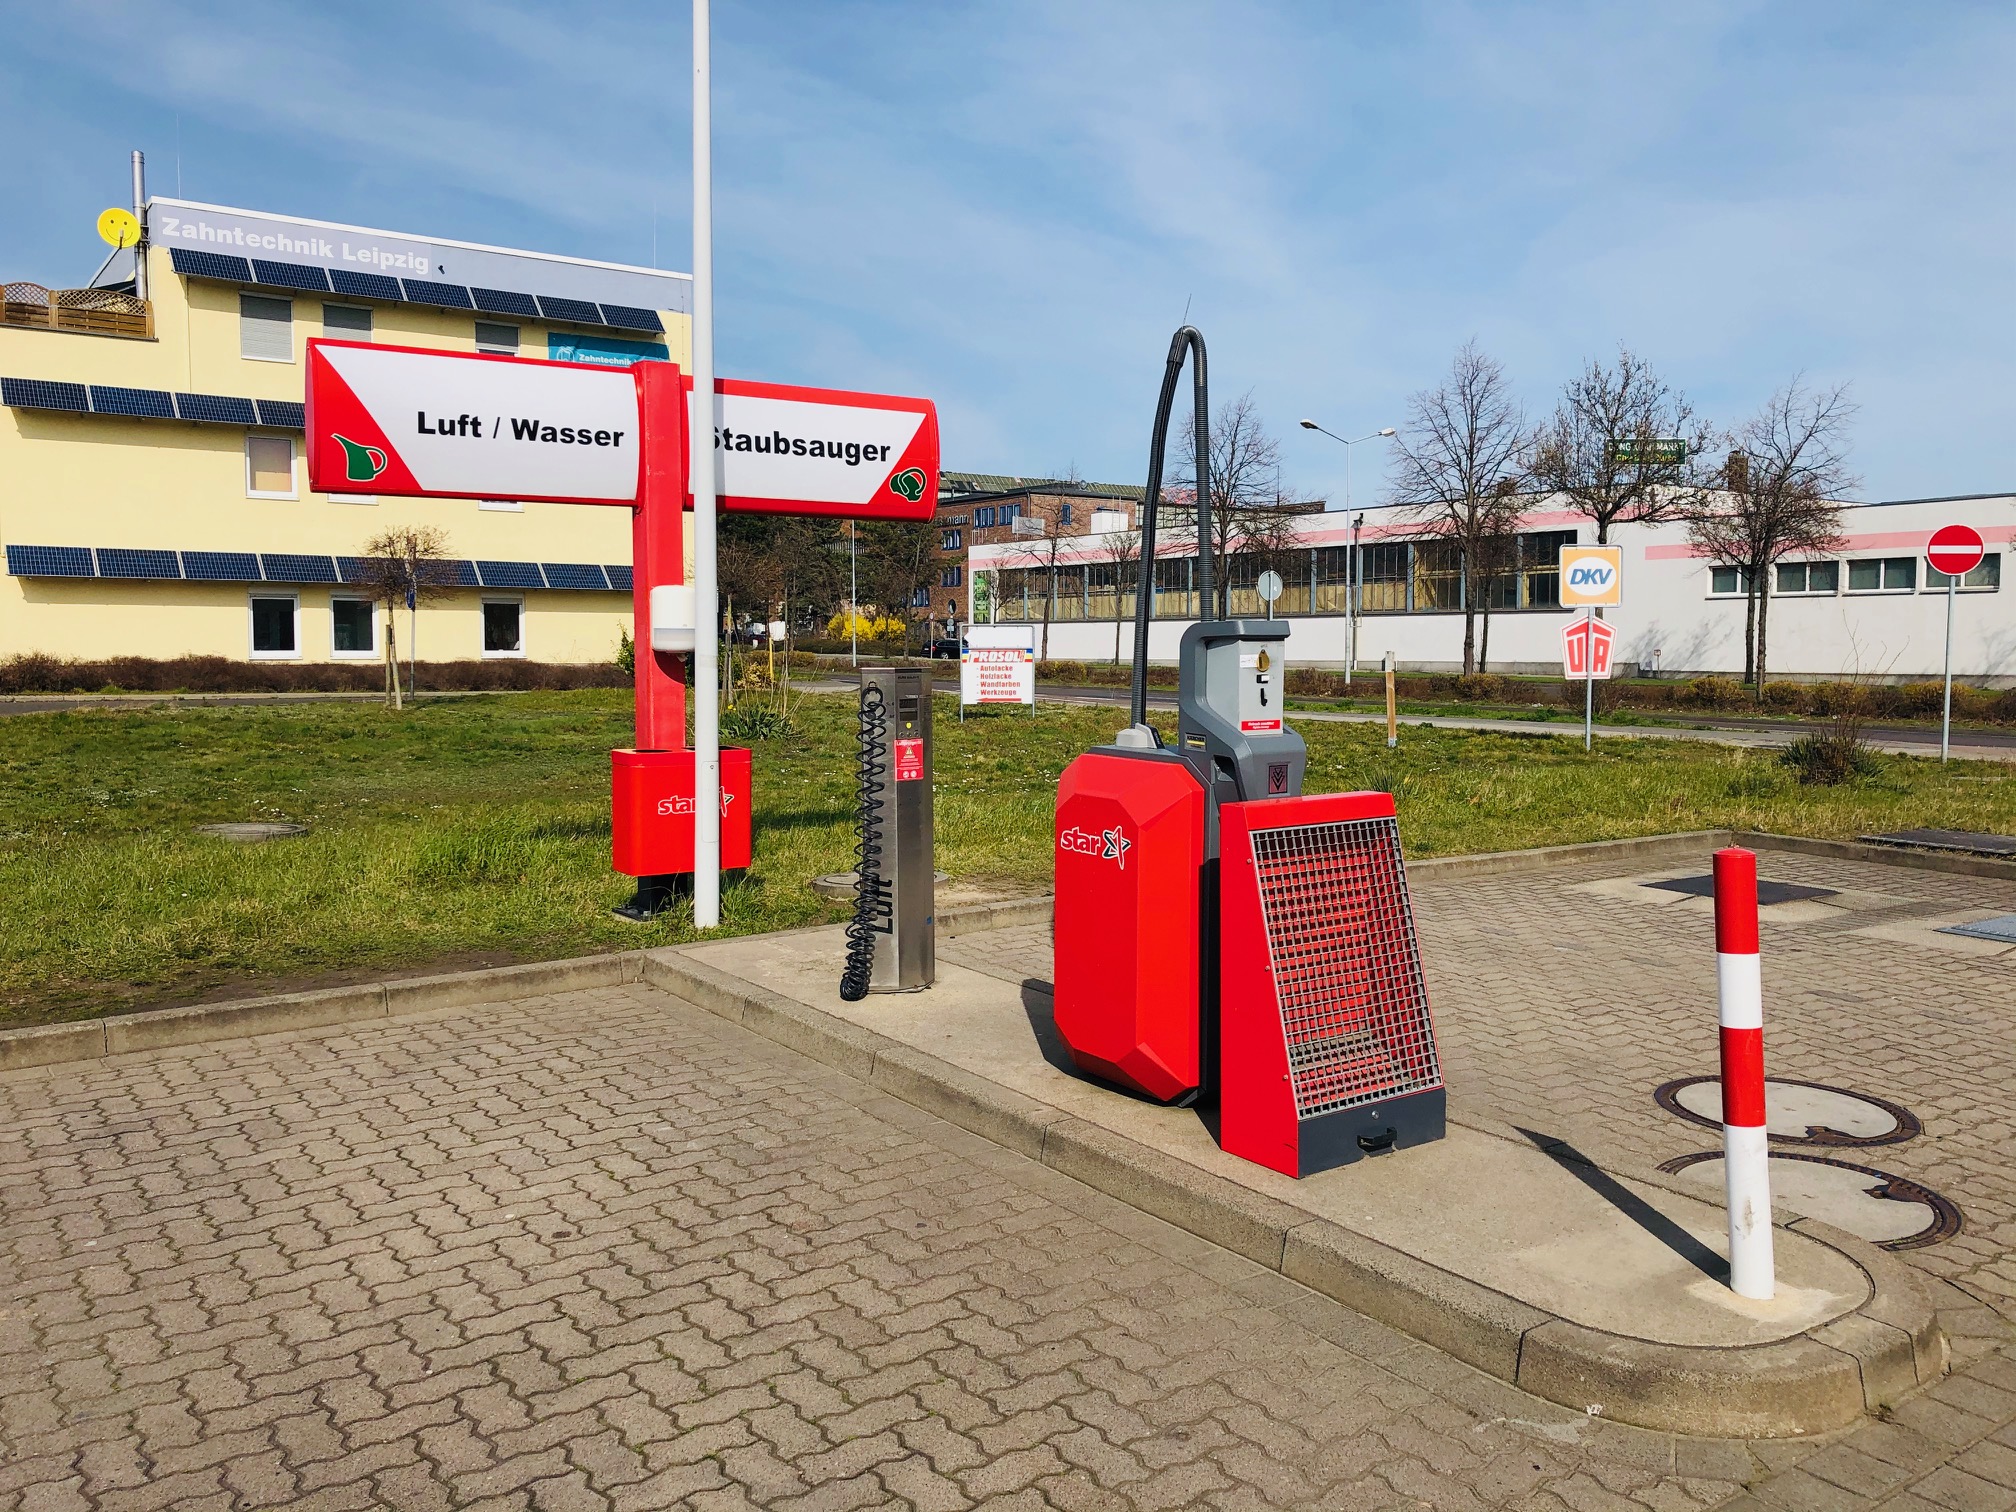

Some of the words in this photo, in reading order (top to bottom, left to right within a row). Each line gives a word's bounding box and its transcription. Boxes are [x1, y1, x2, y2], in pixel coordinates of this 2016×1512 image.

[162, 217, 334, 258] Zahntechnik
[343, 243, 429, 275] Leipzig
[579, 353, 631, 365] Zahntechnik
[417, 411, 482, 437] Luft
[493, 416, 500, 439] /
[510, 418, 624, 447] Wasser
[1570, 568, 1613, 585] DKV
[969, 650, 1019, 663] PROSOL
[1061, 826, 1101, 855] star
